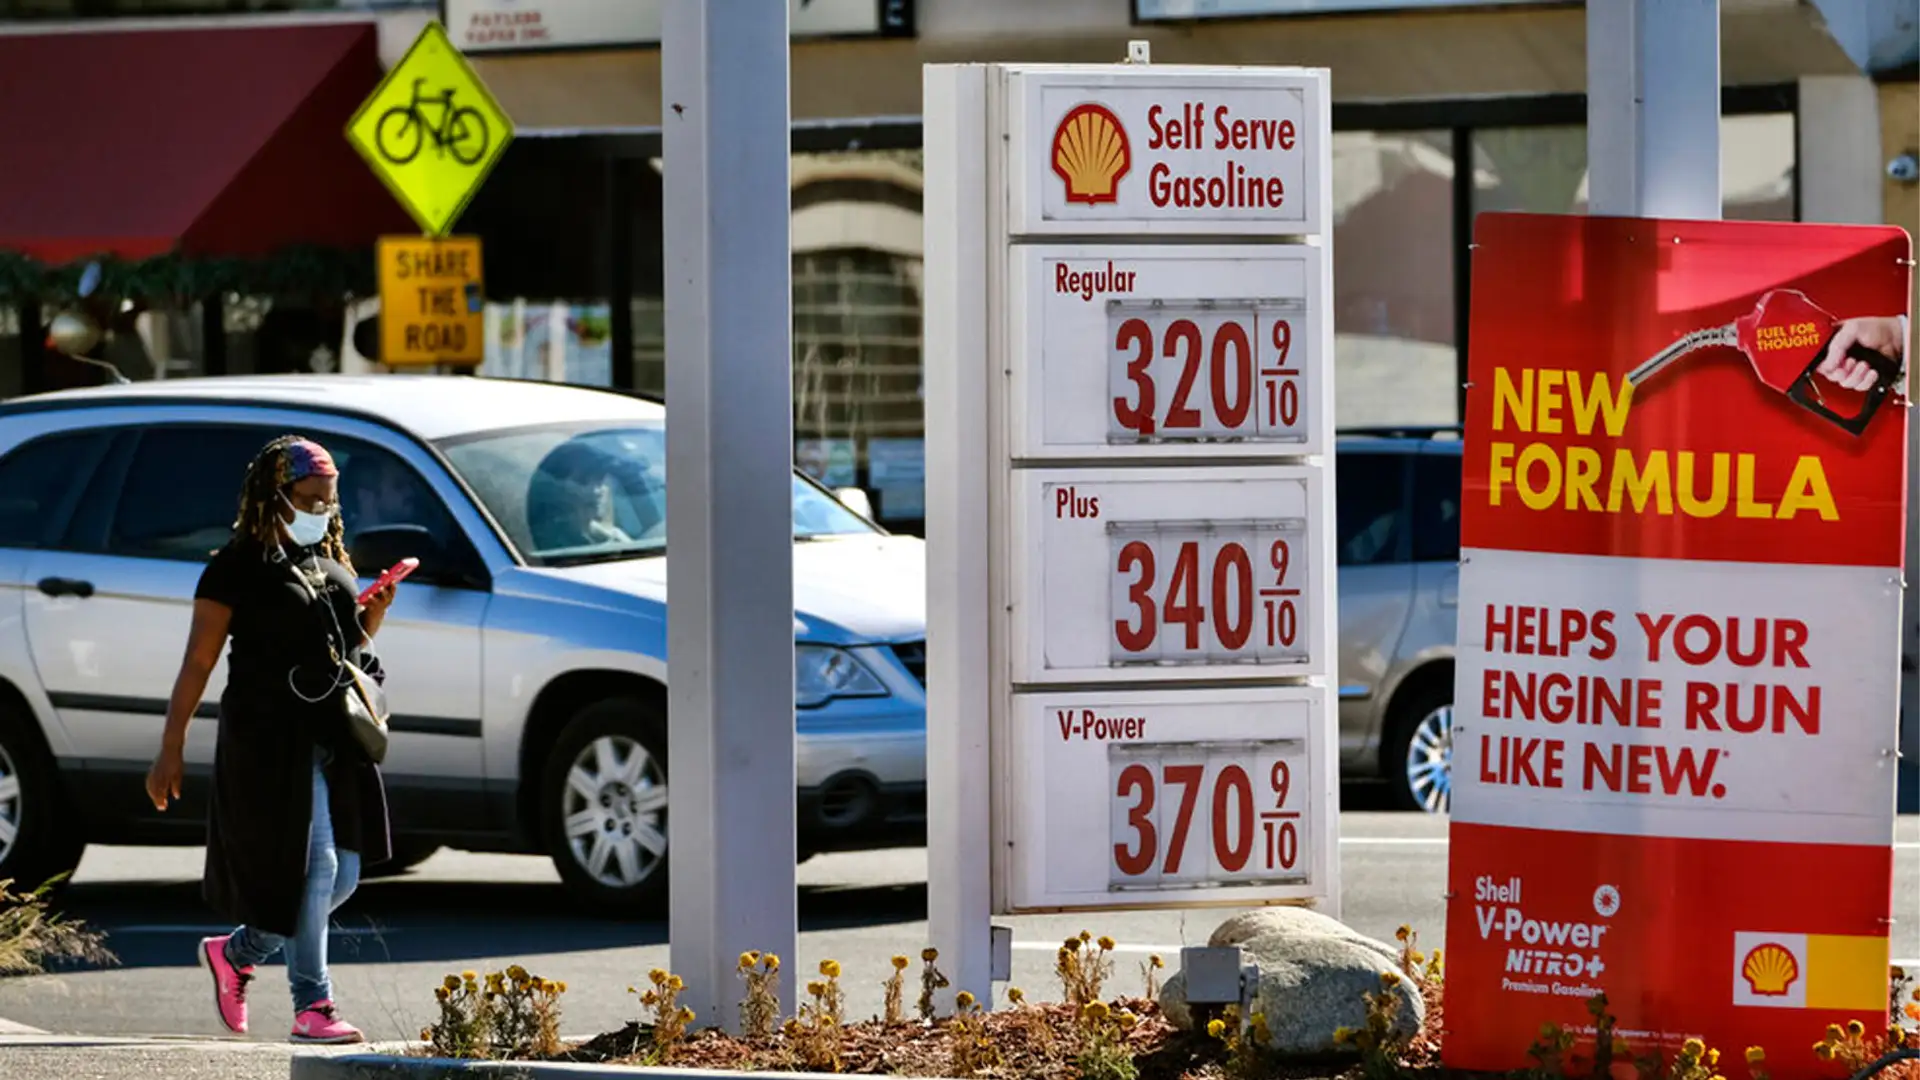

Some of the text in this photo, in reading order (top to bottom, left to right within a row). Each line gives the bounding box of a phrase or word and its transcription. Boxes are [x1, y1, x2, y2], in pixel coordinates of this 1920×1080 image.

[1147, 102, 1296, 150] Self Serve
[1149, 160, 1284, 207] Gasoline
[396, 249, 470, 280] SHARE
[1055, 260, 1136, 300] Regular
[419, 287, 456, 317] THE
[405, 323, 467, 352] ROAD
[1756, 332, 1819, 351] THOUGHT
[1757, 322, 1816, 339] FUEL FOR
[1113, 318, 1252, 435] 320
[1492, 366, 1636, 436] NEW
[1055, 486, 1099, 519] Plus
[1489, 442, 1840, 521] FORMULA
[1114, 540, 1254, 652] 340
[1485, 604, 1811, 668] HELPS YOUR
[1482, 669, 1821, 736] ENGINE RUN
[1058, 709, 1146, 741] V-Power
[1479, 734, 1564, 788] LIKE
[1113, 763, 1255, 876] 370
[1475, 875, 1521, 903] Shell
[1475, 905, 1607, 948] V-Power
[1502, 977, 1549, 993] Premium
